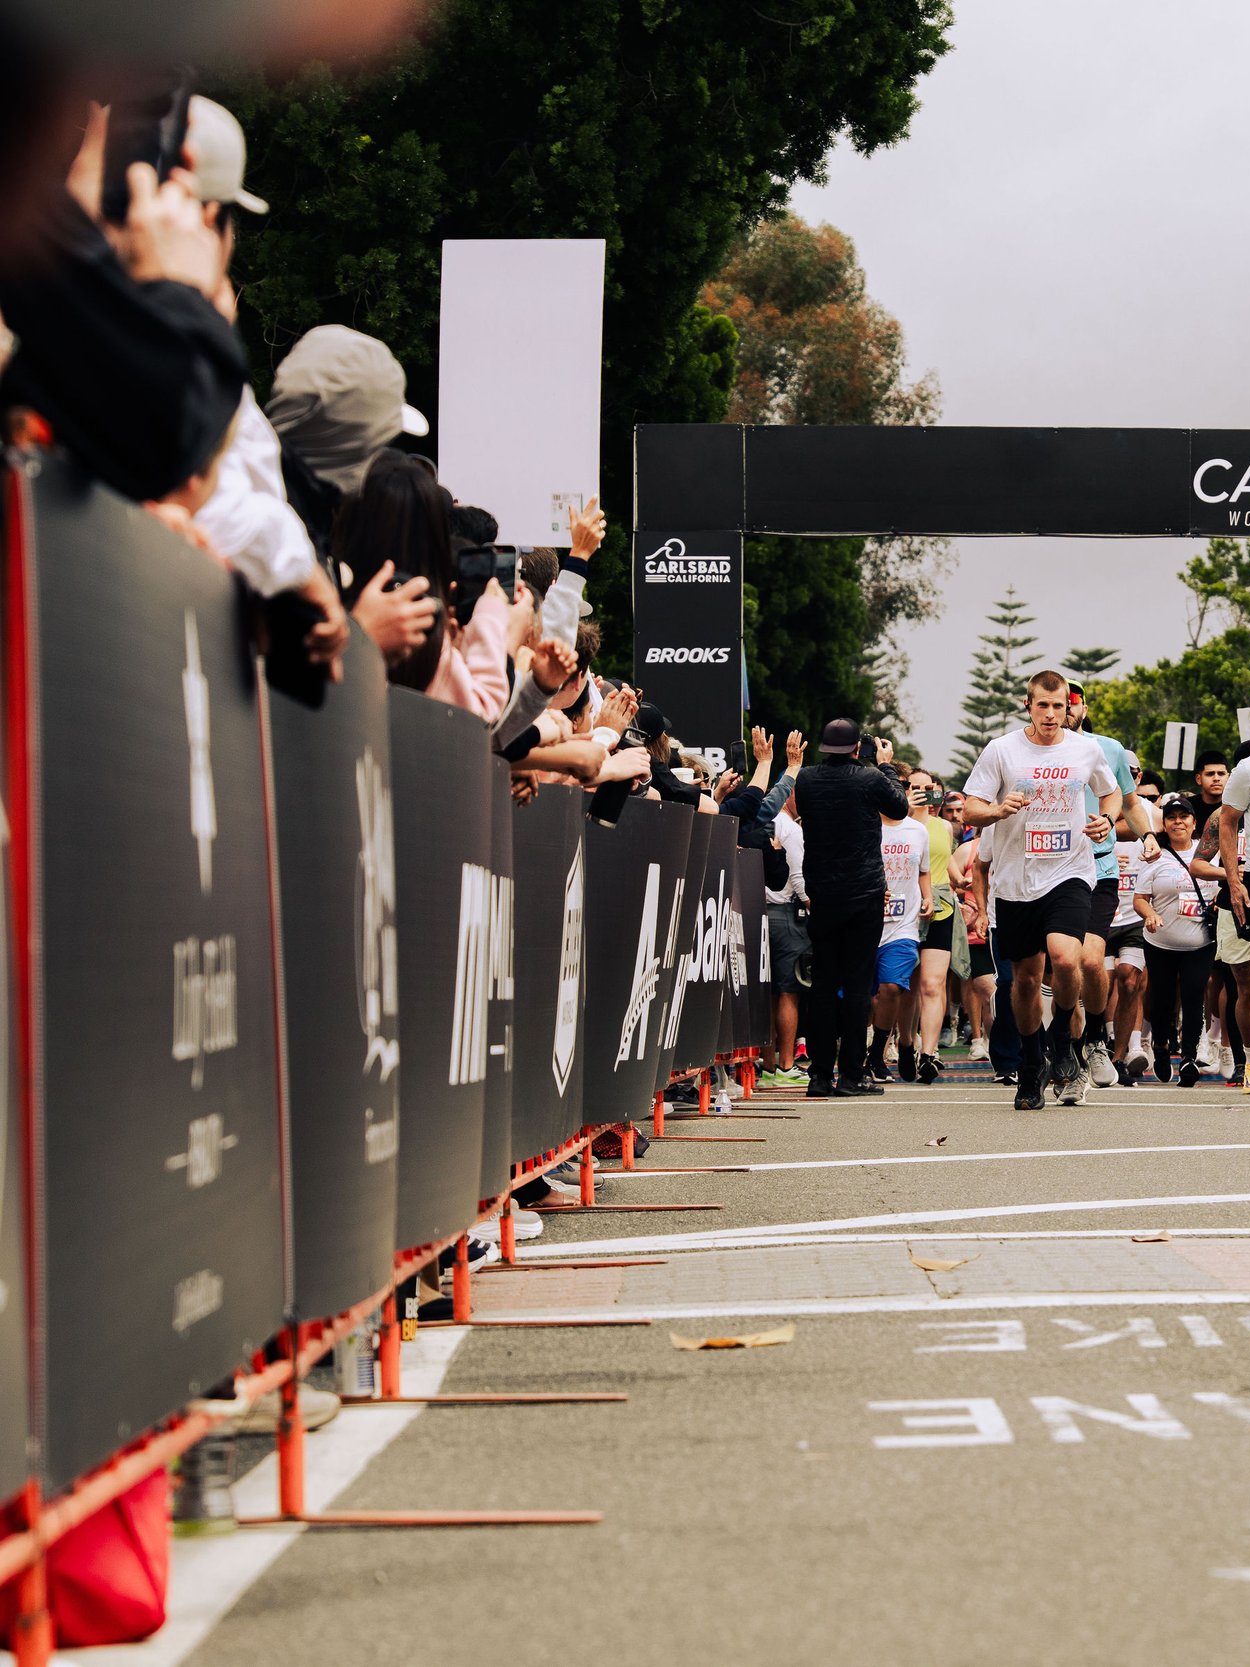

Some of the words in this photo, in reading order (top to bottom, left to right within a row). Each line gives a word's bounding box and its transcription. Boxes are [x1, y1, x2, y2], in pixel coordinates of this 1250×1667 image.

[645, 561, 731, 574] CARLSBAD
[667, 575, 731, 583] CALIFORNIA
[645, 648, 731, 663] BROOKS
[1033, 767, 1069, 779] 5000
[1033, 834, 1068, 850] 6851
[883, 844, 910, 855] 5000
